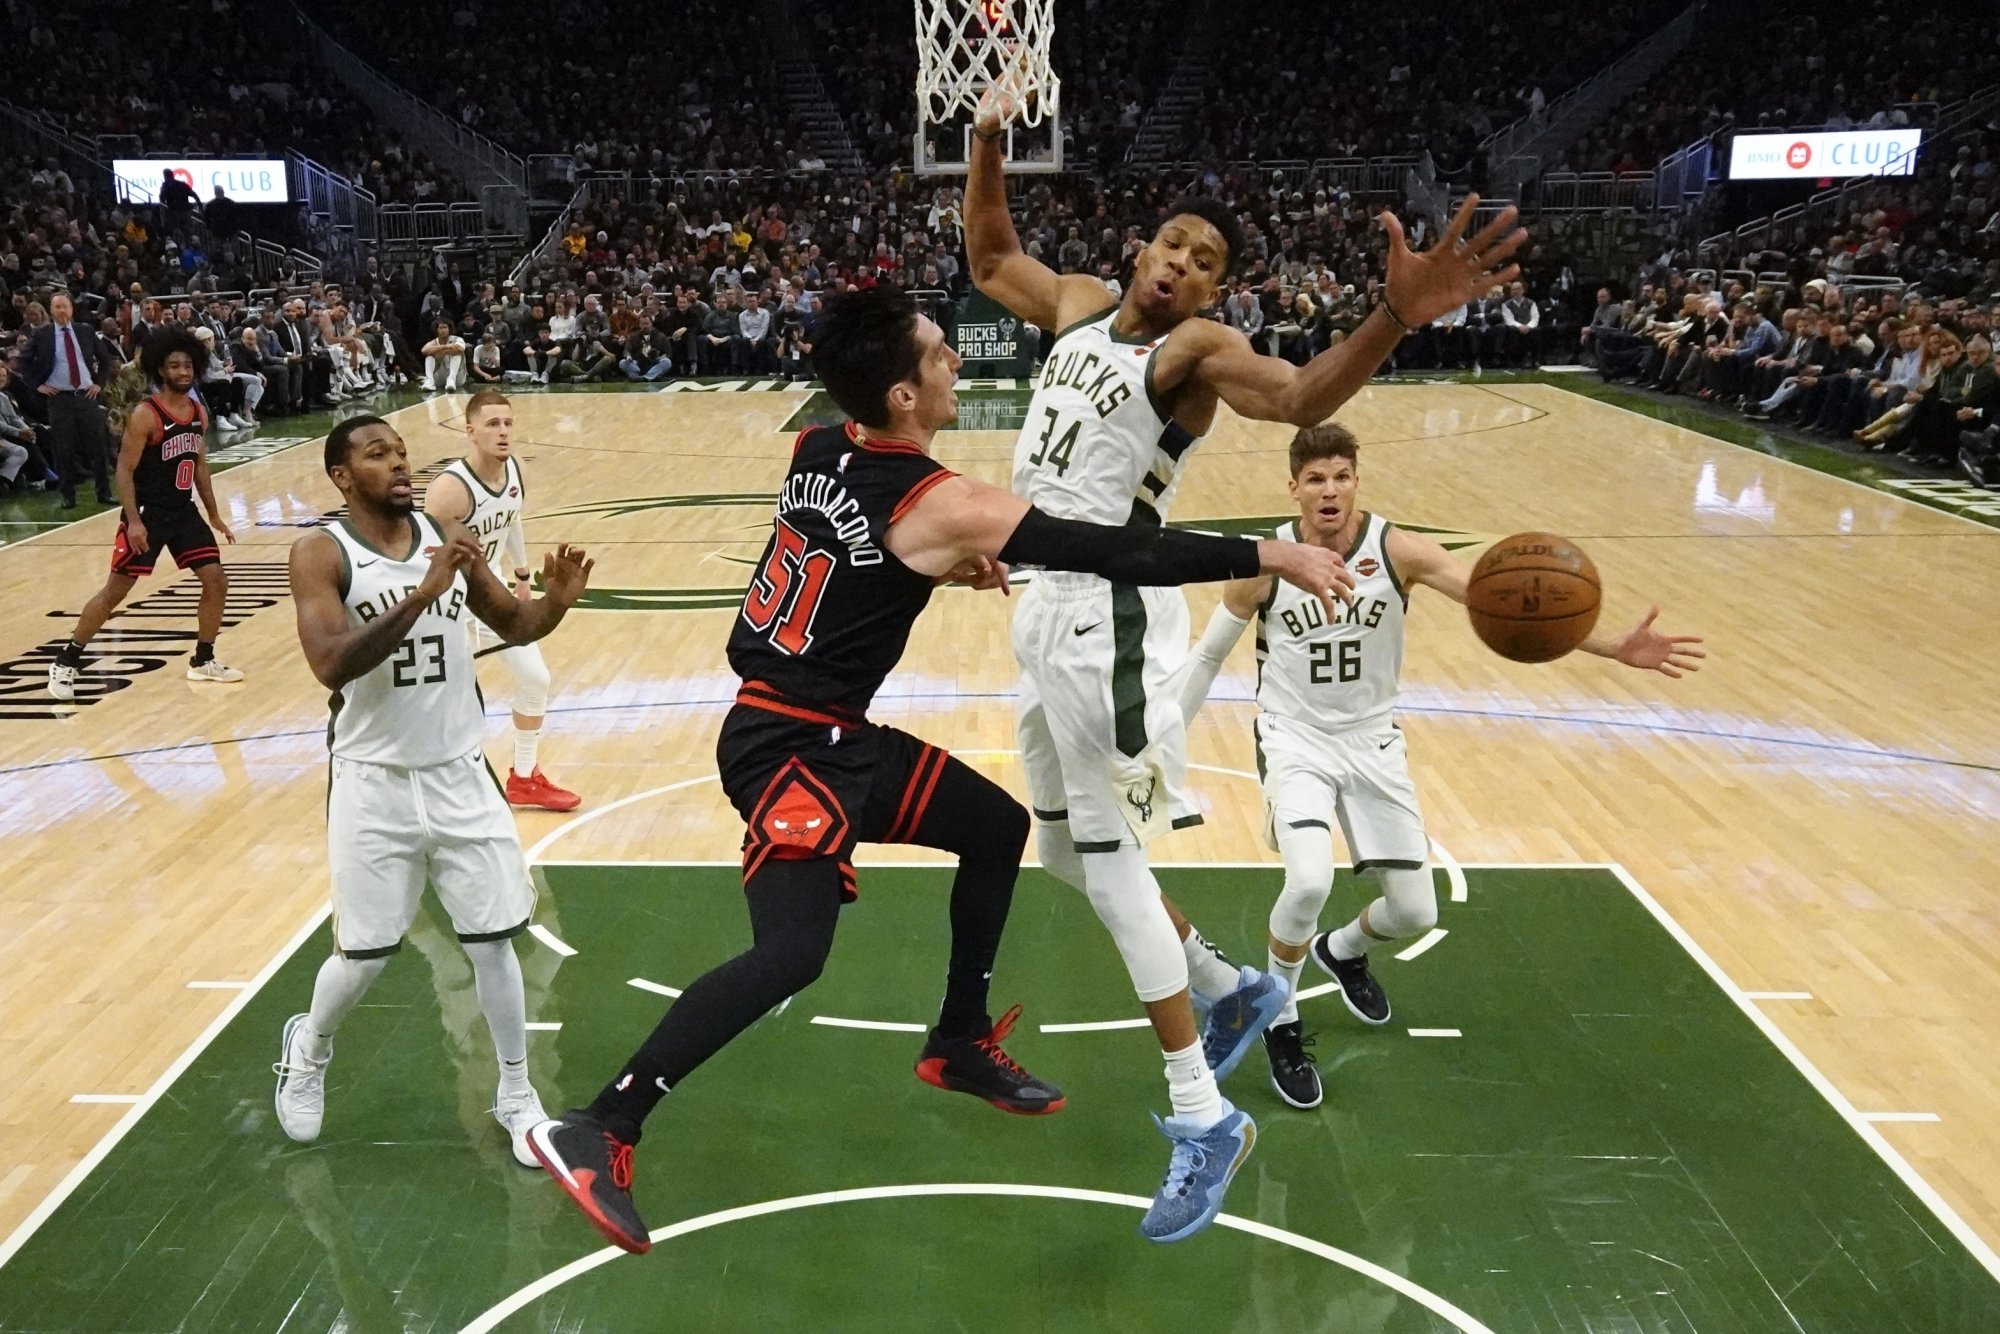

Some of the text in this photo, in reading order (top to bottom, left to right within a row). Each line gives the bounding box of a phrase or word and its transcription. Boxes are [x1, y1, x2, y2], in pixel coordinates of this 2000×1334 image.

[1747, 141, 1902, 165] BMO CLUB
[211, 171, 272, 191] CLUB
[957, 326, 998, 342] BUCKS
[957, 341, 1017, 357] PRO SHOP
[1042, 351, 1132, 419] BUCKS
[162, 432, 202, 461] CHICAG
[1029, 406, 1083, 478] 34
[175, 459, 195, 490] 0
[468, 509, 520, 539] BUCK
[1486, 544, 1582, 570] SPALDI
[742, 515, 837, 656] 51
[393, 634, 447, 687] 23
[1309, 640, 1361, 684] 26
